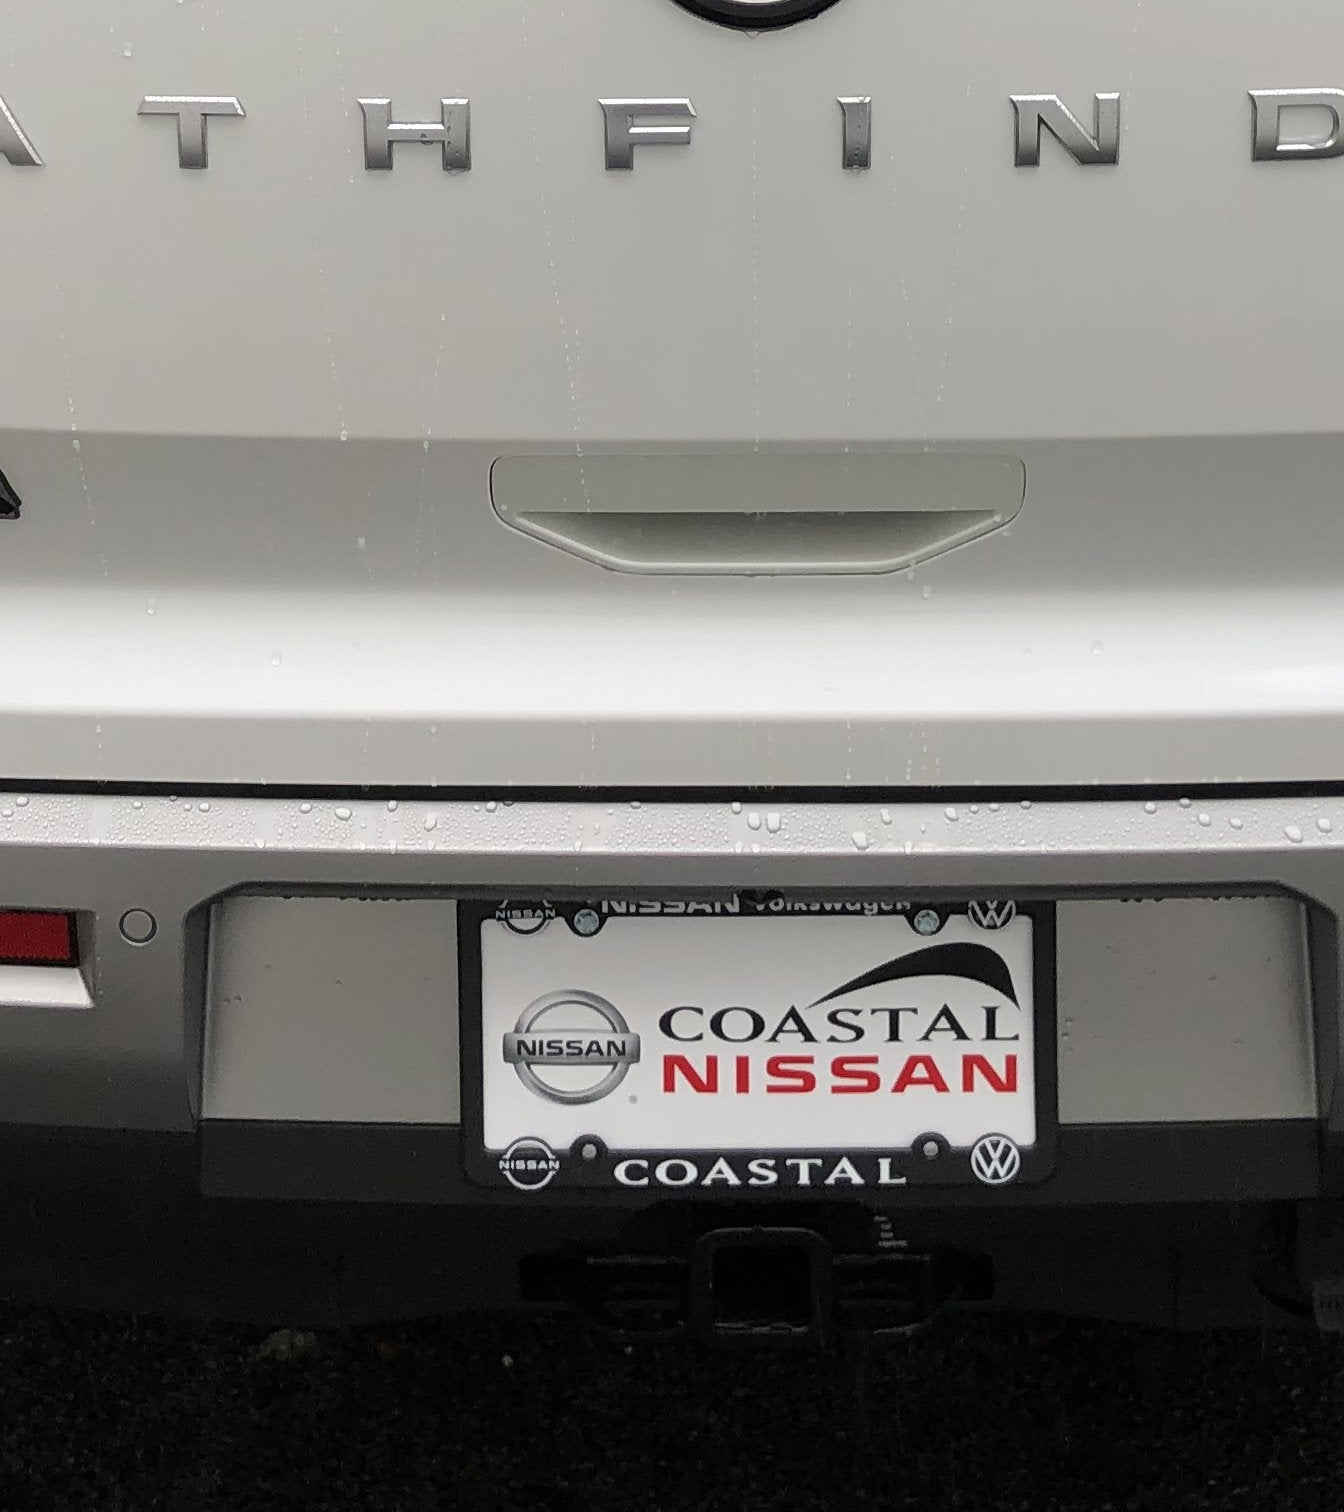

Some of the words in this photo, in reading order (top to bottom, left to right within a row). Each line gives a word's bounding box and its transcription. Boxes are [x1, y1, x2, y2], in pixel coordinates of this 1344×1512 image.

[658, 1003, 1021, 1044] COASTAL
[515, 1037, 628, 1059] NISSAN
[662, 1053, 1019, 1095] NISSAN
[498, 1158, 561, 1171] NISSAN
[613, 1156, 907, 1186] COASTAL
